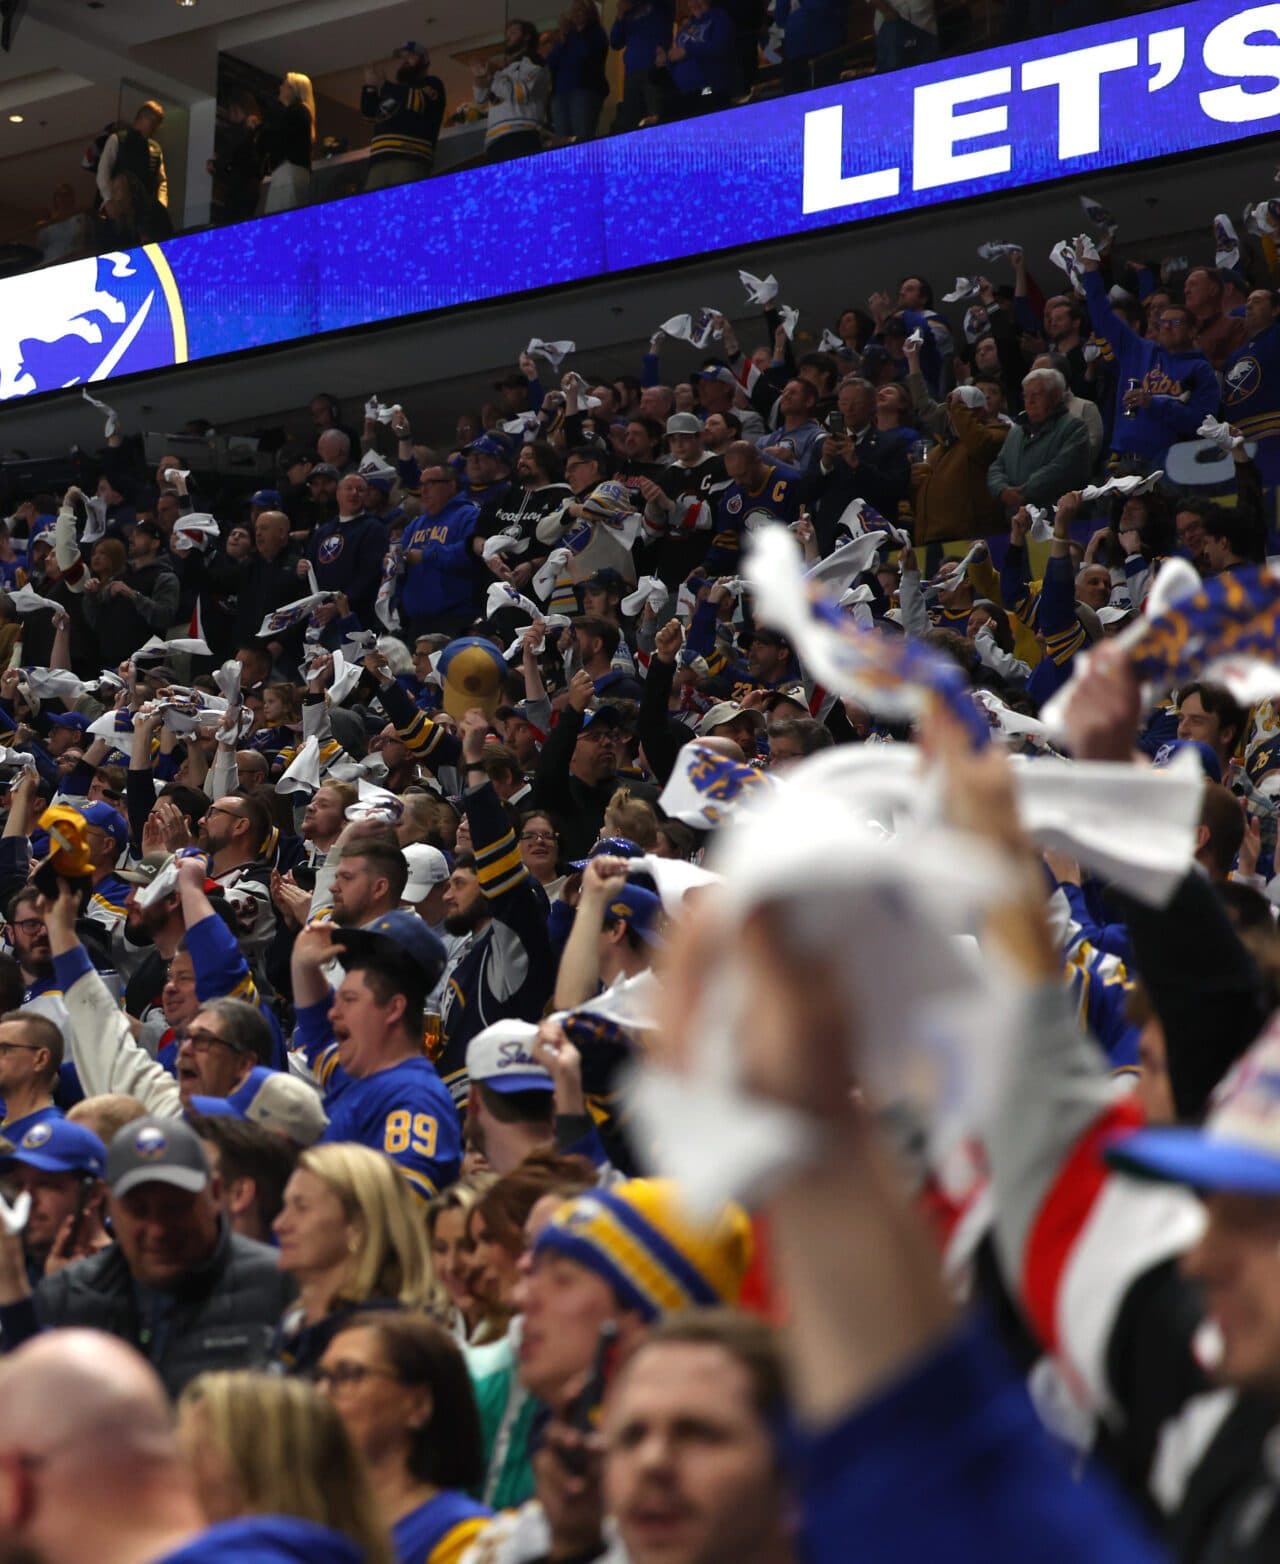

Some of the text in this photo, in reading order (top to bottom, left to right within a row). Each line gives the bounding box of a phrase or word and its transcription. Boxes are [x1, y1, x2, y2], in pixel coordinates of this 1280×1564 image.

[803, 2, 1280, 215] LET'S
[772, 481, 788, 503] C
[384, 1109, 439, 1157] 89
